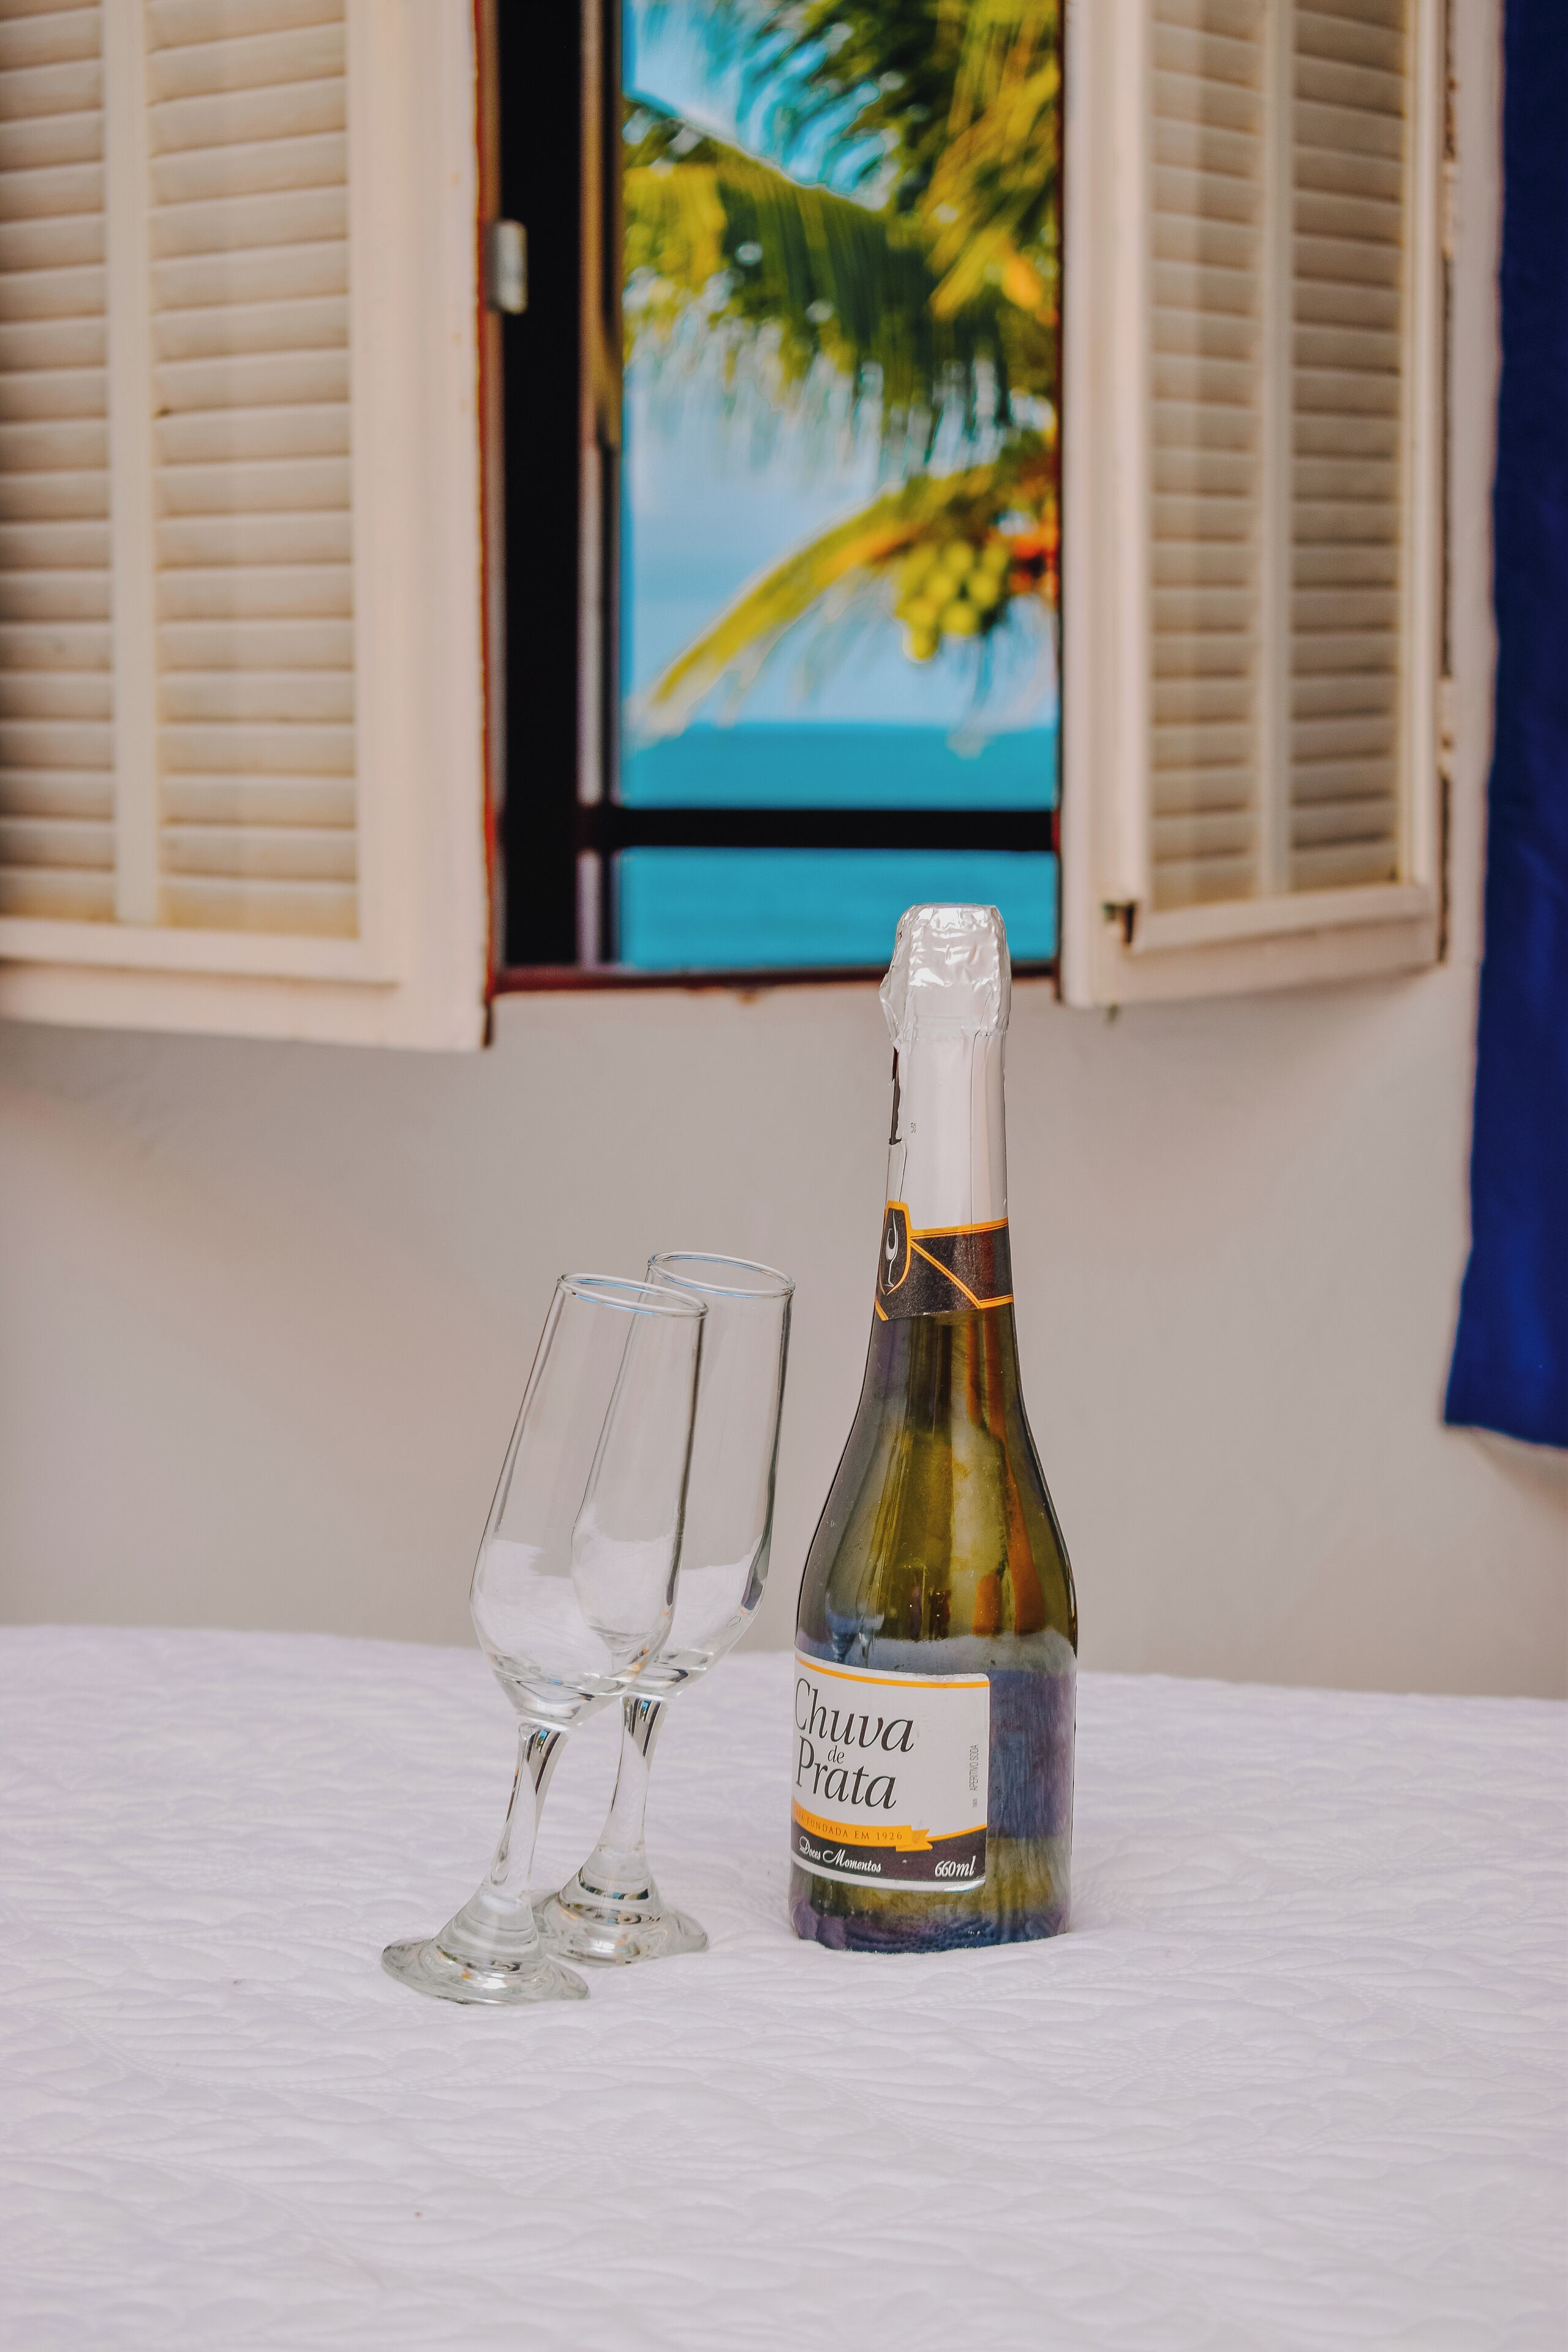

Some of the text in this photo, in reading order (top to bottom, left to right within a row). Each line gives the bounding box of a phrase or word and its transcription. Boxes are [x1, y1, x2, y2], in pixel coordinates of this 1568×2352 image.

[795, 1677, 914, 1752] Chuva
[827, 1745, 845, 1763] de
[795, 1735, 897, 1809] Prata
[806, 1816, 848, 1838] FUNDADA
[854, 1830, 870, 1840] EM
[876, 1831, 902, 1841] 1926
[799, 1835, 882, 1873] Doces Momentos
[935, 1855, 976, 1877] 660ml
